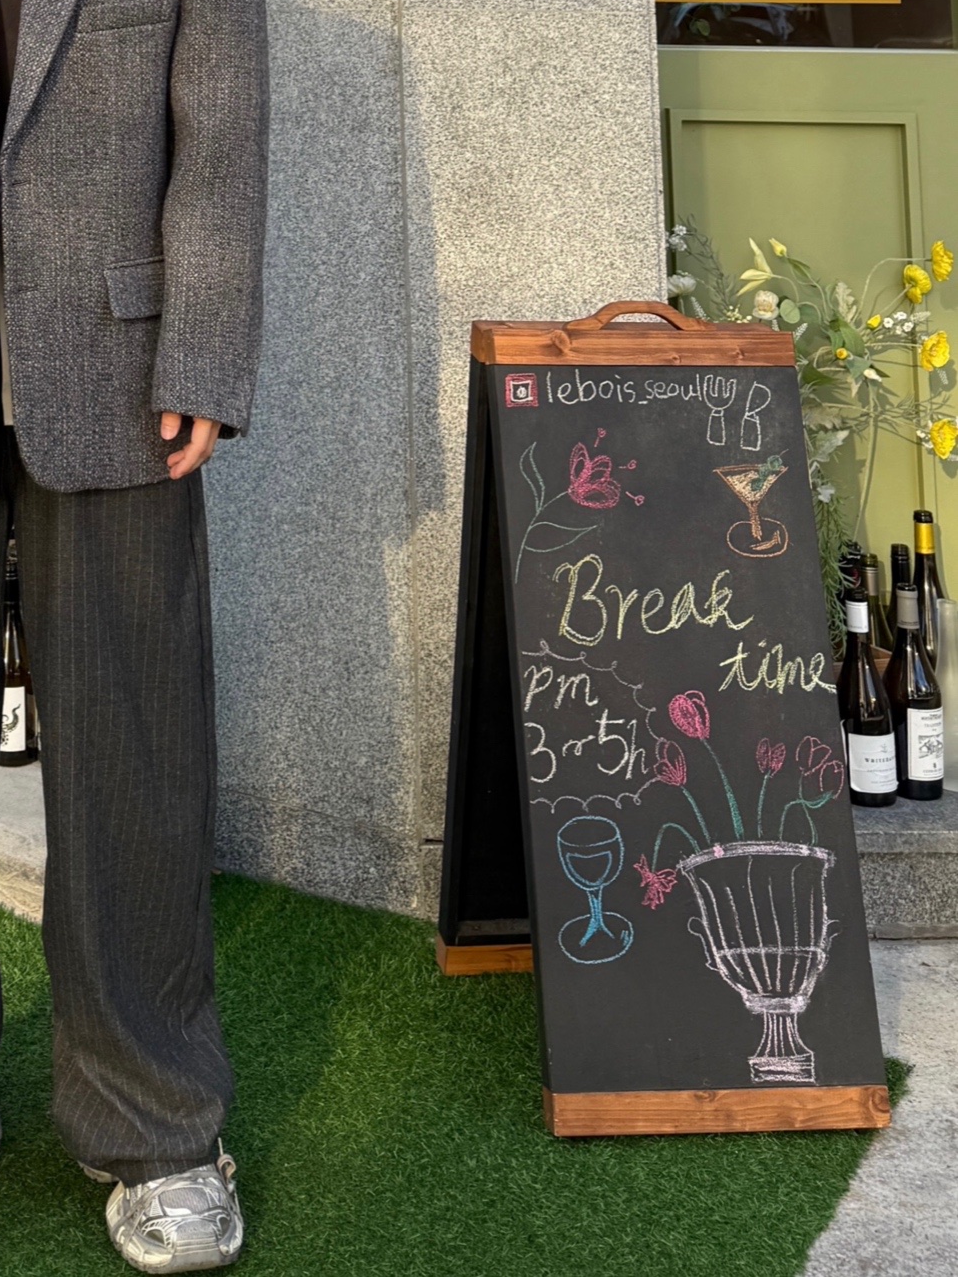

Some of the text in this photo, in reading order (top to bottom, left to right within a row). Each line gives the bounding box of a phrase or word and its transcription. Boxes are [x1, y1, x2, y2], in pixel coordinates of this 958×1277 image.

[546, 368, 703, 405] lebois_seoul
[552, 553, 755, 647] Break
[523, 664, 600, 713] pm
[718, 638, 838, 695] time
